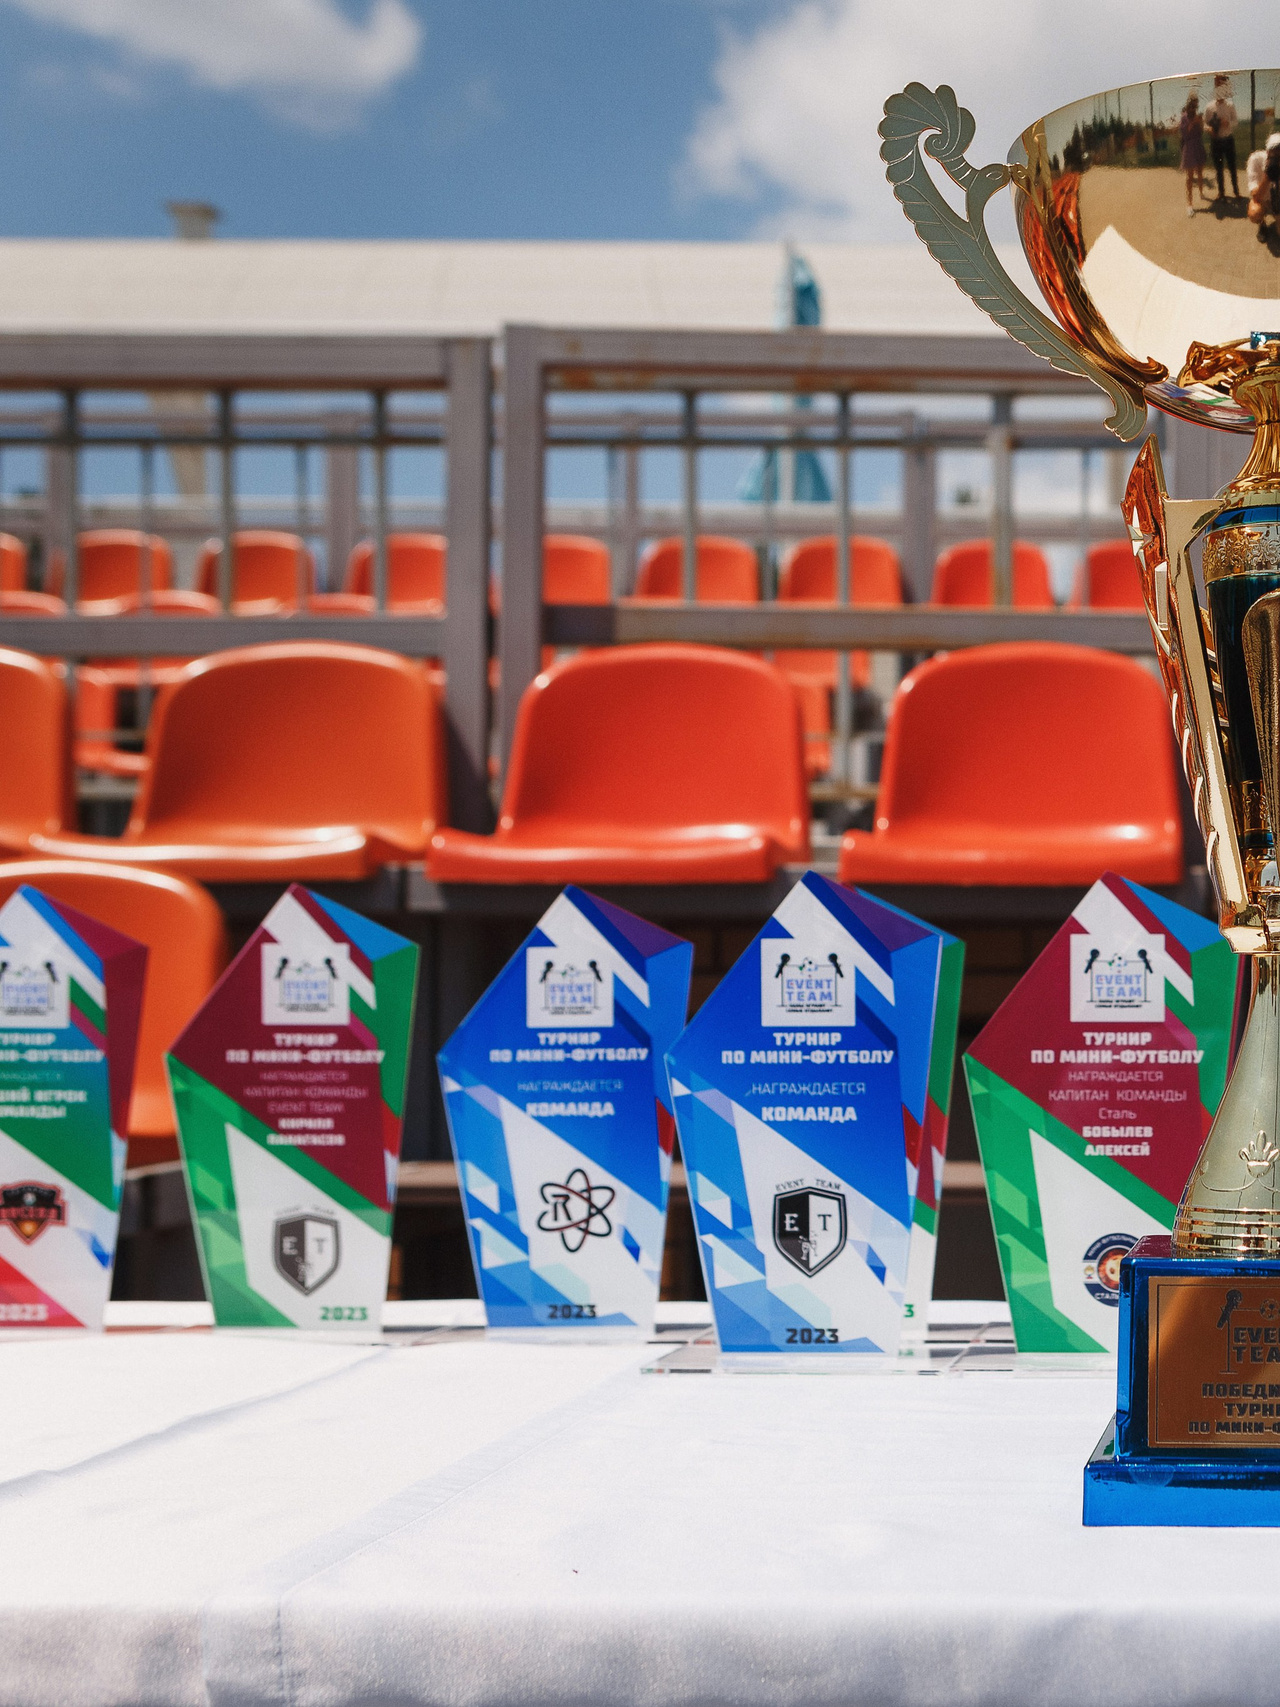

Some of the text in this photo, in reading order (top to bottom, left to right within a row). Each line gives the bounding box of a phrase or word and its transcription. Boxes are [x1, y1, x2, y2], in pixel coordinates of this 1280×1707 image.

[786, 979, 833, 990] EVENT
[1095, 974, 1142, 985] EVENT
[550, 983, 592, 993] EVENT
[1096, 986, 1142, 998] TEAM
[550, 995, 593, 1004] TEAM
[786, 991, 833, 1002] TEAM
[0, 1033, 56, 1045] УРНИР
[273, 1033, 338, 1046] ТУРНИР
[537, 1032, 601, 1045] ТУРНИР
[773, 1032, 842, 1046] ТУРНИР
[1082, 1031, 1152, 1046] ТУРНИР
[225, 1050, 249, 1063] ПО
[489, 1047, 649, 1063] ПО МИНИ-ФУТБОЛУ
[721, 1049, 894, 1064] ПО МИНИ-ФУТБОЛУ
[1031, 1049, 1204, 1064] ПО МИНИ-ФУТБОЛУ
[1068, 1071, 1163, 1083] НАГРАЖДАЕТСЯ
[517, 1079, 623, 1093] НАГРАЖДАЕТСЯ
[751, 1082, 866, 1096] НАГРАЖДАЕТСЯ
[1048, 1089, 1187, 1103] КАПИТАН КОМАНДЫ
[525, 1102, 615, 1118] КОМАНДА
[761, 1107, 858, 1124] КОМАНДА
[1098, 1107, 1137, 1120] Сталь
[1082, 1126, 1153, 1138] БОБЫЛЕВ
[1084, 1142, 1150, 1157] АЛЕКСЕЙ
[784, 1213, 832, 1232] E T
[283, 1236, 327, 1255] E T
[320, 1306, 368, 1321] 2023
[549, 1304, 596, 1319] 2023
[785, 1328, 839, 1344] 2023
[1188, 1421, 1210, 1435] ПО
